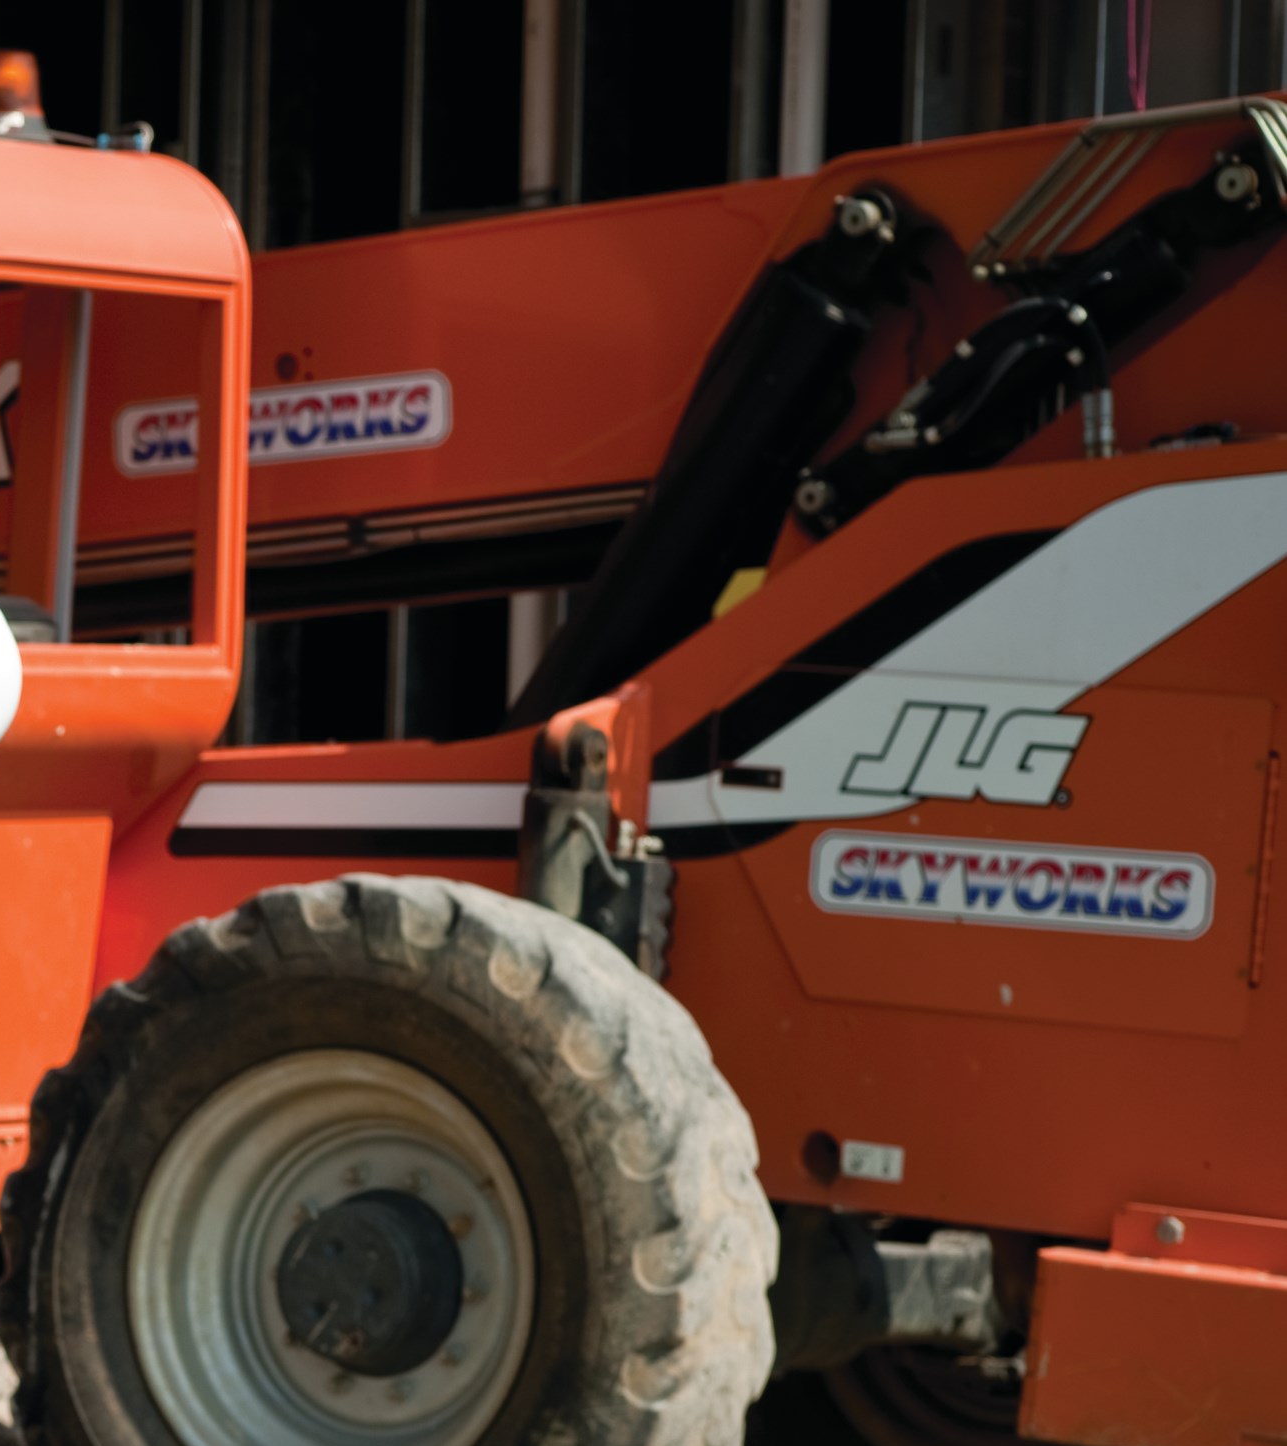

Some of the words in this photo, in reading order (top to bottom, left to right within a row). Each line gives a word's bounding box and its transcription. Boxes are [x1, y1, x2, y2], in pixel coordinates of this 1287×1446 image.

[131, 384, 431, 464] SKWORKS
[839, 700, 1093, 809] JLG
[831, 846, 1192, 923] SKYWORKS
